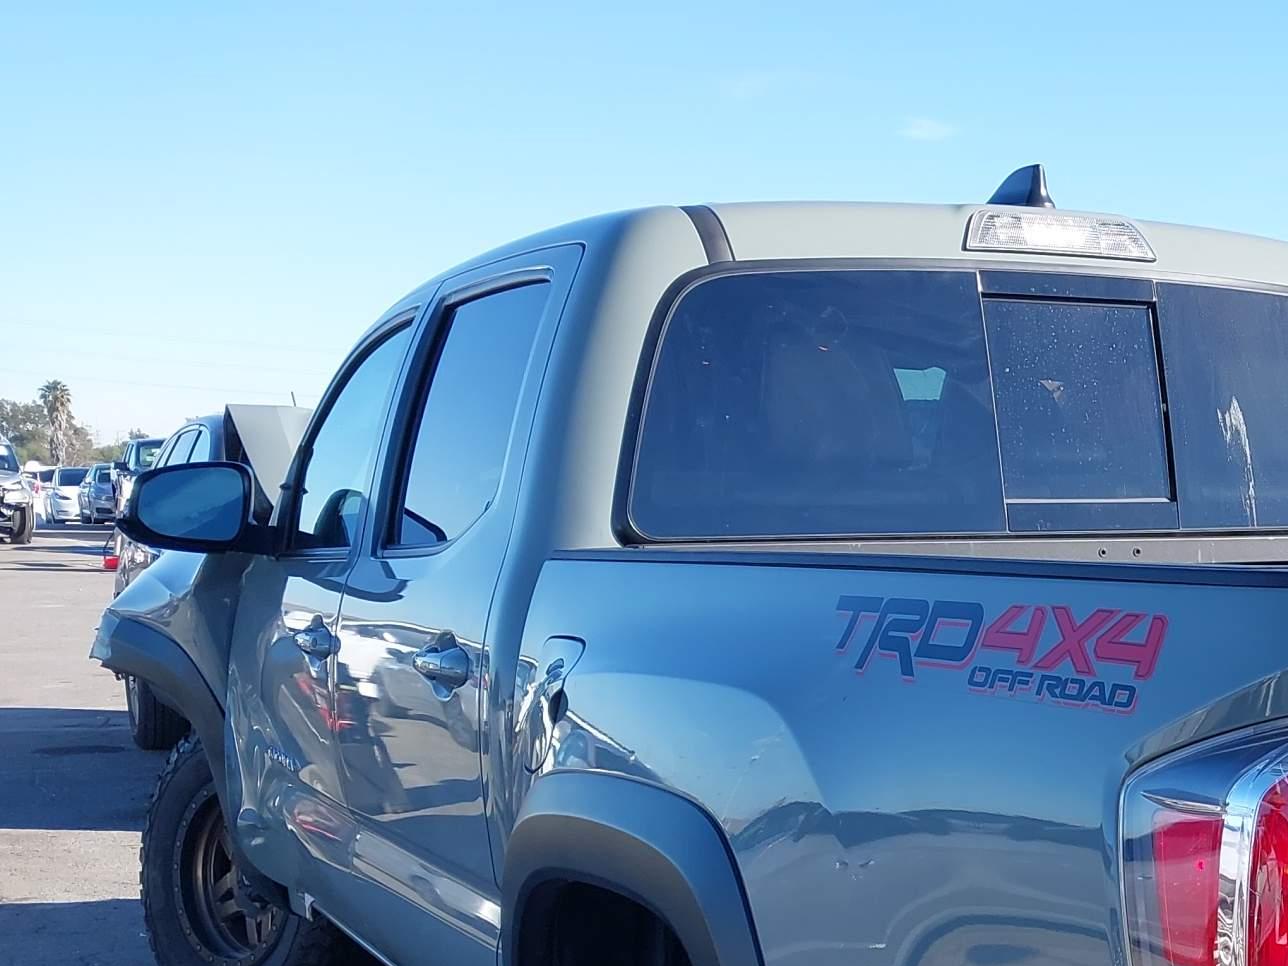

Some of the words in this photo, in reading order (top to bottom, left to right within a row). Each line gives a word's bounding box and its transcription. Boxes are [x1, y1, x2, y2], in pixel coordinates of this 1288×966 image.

[836, 594, 985, 682] TRD
[967, 665, 1034, 696] OFF
[1035, 673, 1139, 716] ROAD
